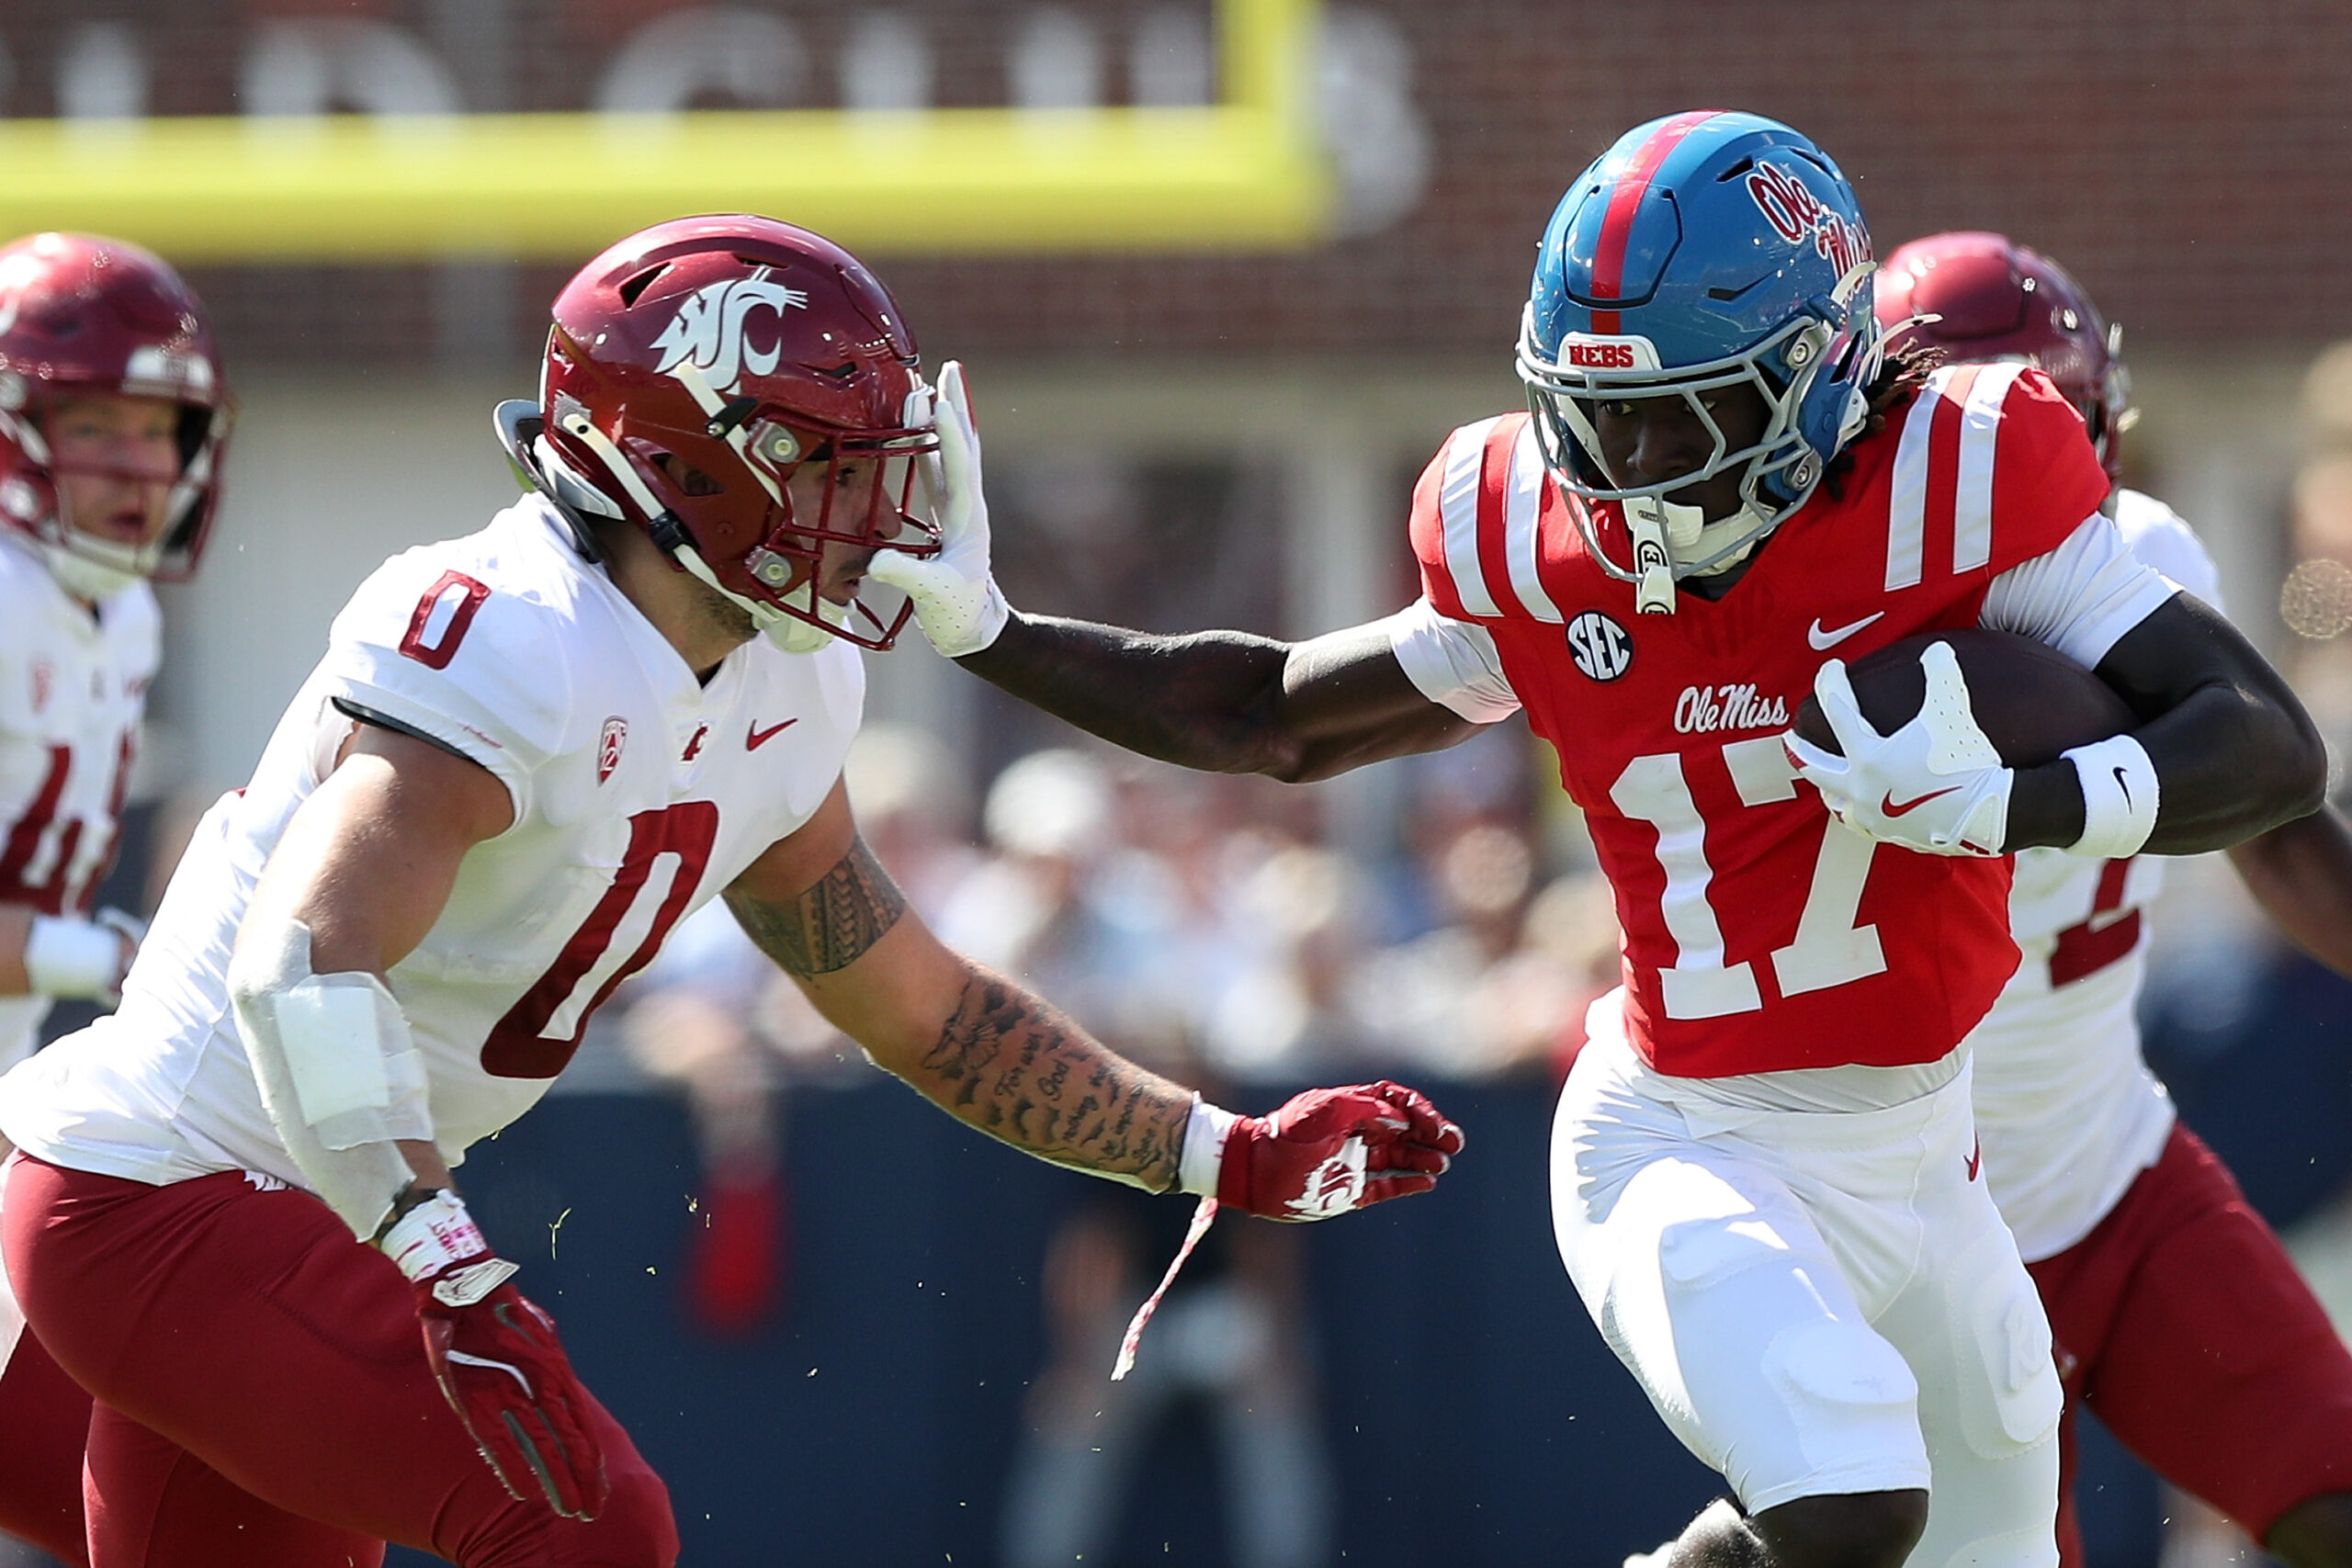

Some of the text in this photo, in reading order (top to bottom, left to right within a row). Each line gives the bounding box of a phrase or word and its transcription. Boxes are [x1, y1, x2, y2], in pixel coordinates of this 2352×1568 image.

[1746, 161, 1823, 244] Ole
[1568, 343, 1634, 367] REBS
[398, 569, 492, 671] 0
[1567, 613, 1632, 681] SEC
[1674, 683, 1791, 734] Ole Miss
[1608, 732, 1889, 1020] 17
[480, 799, 719, 1080] 0
